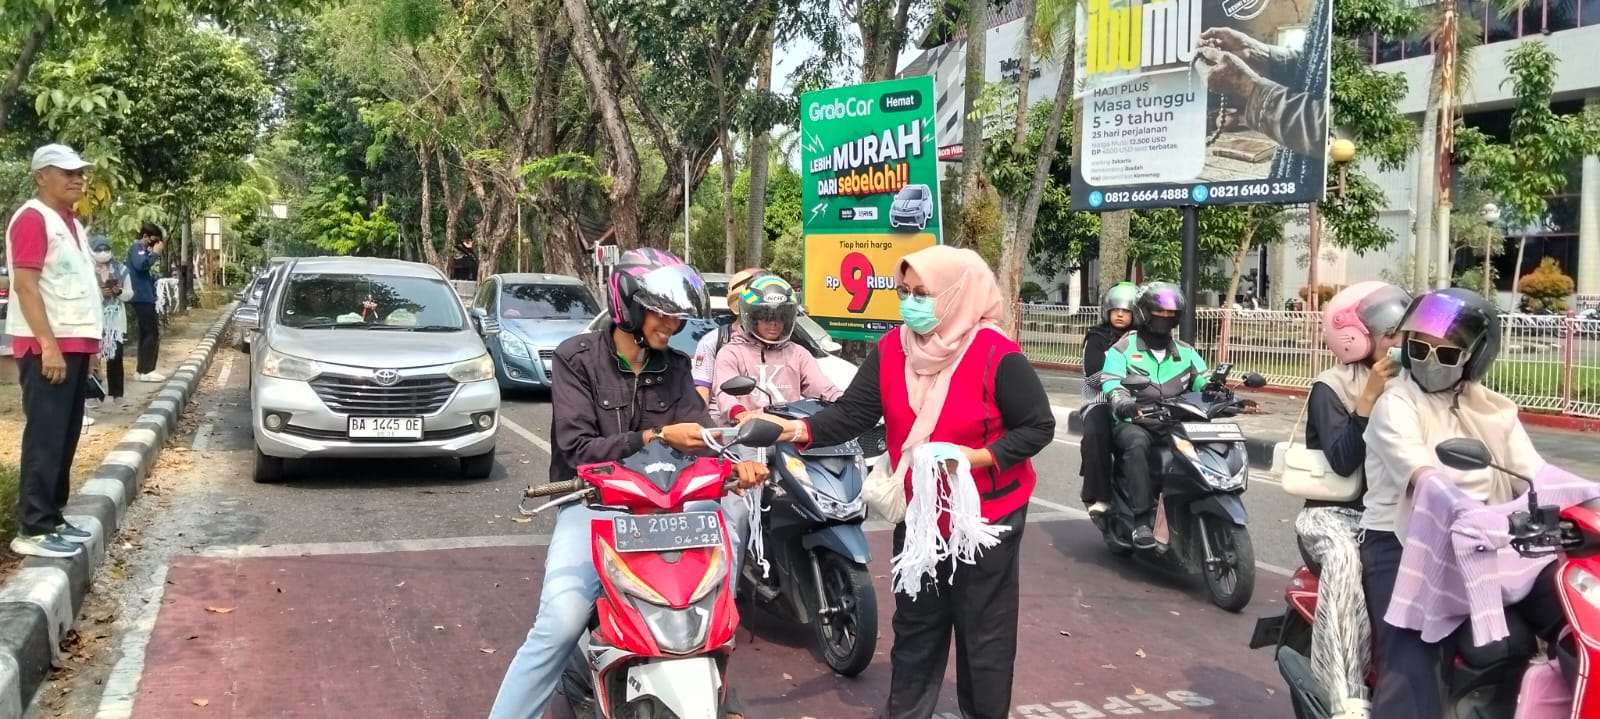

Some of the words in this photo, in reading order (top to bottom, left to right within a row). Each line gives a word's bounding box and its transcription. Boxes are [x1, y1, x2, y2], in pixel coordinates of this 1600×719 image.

[1093, 87, 1118, 97] HAJI
[1121, 82, 1149, 94] PLUS
[809, 97, 874, 121] GrabCar
[886, 95, 914, 108] Hemat
[1094, 99, 1131, 113] Masa
[1136, 92, 1195, 108] tunggu
[1092, 116, 1101, 129] 5
[1114, 113, 1123, 126] 9
[1128, 110, 1174, 125] tahun
[1092, 130, 1102, 139] 25
[1103, 128, 1120, 138] hari
[1122, 126, 1168, 138] perjalanan
[810, 154, 832, 173] LEBIH
[833, 119, 921, 171] MURAH
[1149, 143, 1177, 151] terbatas
[818, 178, 837, 195] DARI
[838, 162, 908, 194] sebelah!!
[1105, 191, 1130, 203] 0812
[1131, 189, 1158, 202] 6664
[1160, 188, 1188, 200] 4888
[1209, 185, 1238, 198] 0821
[1240, 183, 1269, 196] 6140
[1271, 182, 1296, 194] 338
[840, 240, 854, 251] Tiap
[855, 240, 869, 249] hari
[870, 240, 893, 251] harga
[826, 275, 840, 290] Rp
[841, 252, 875, 313] 9
[866, 275, 897, 289] RIBU
[352, 419, 366, 430] BA
[372, 418, 400, 430] 1445
[616, 518, 638, 534] BA
[648, 516, 688, 533] 2095
